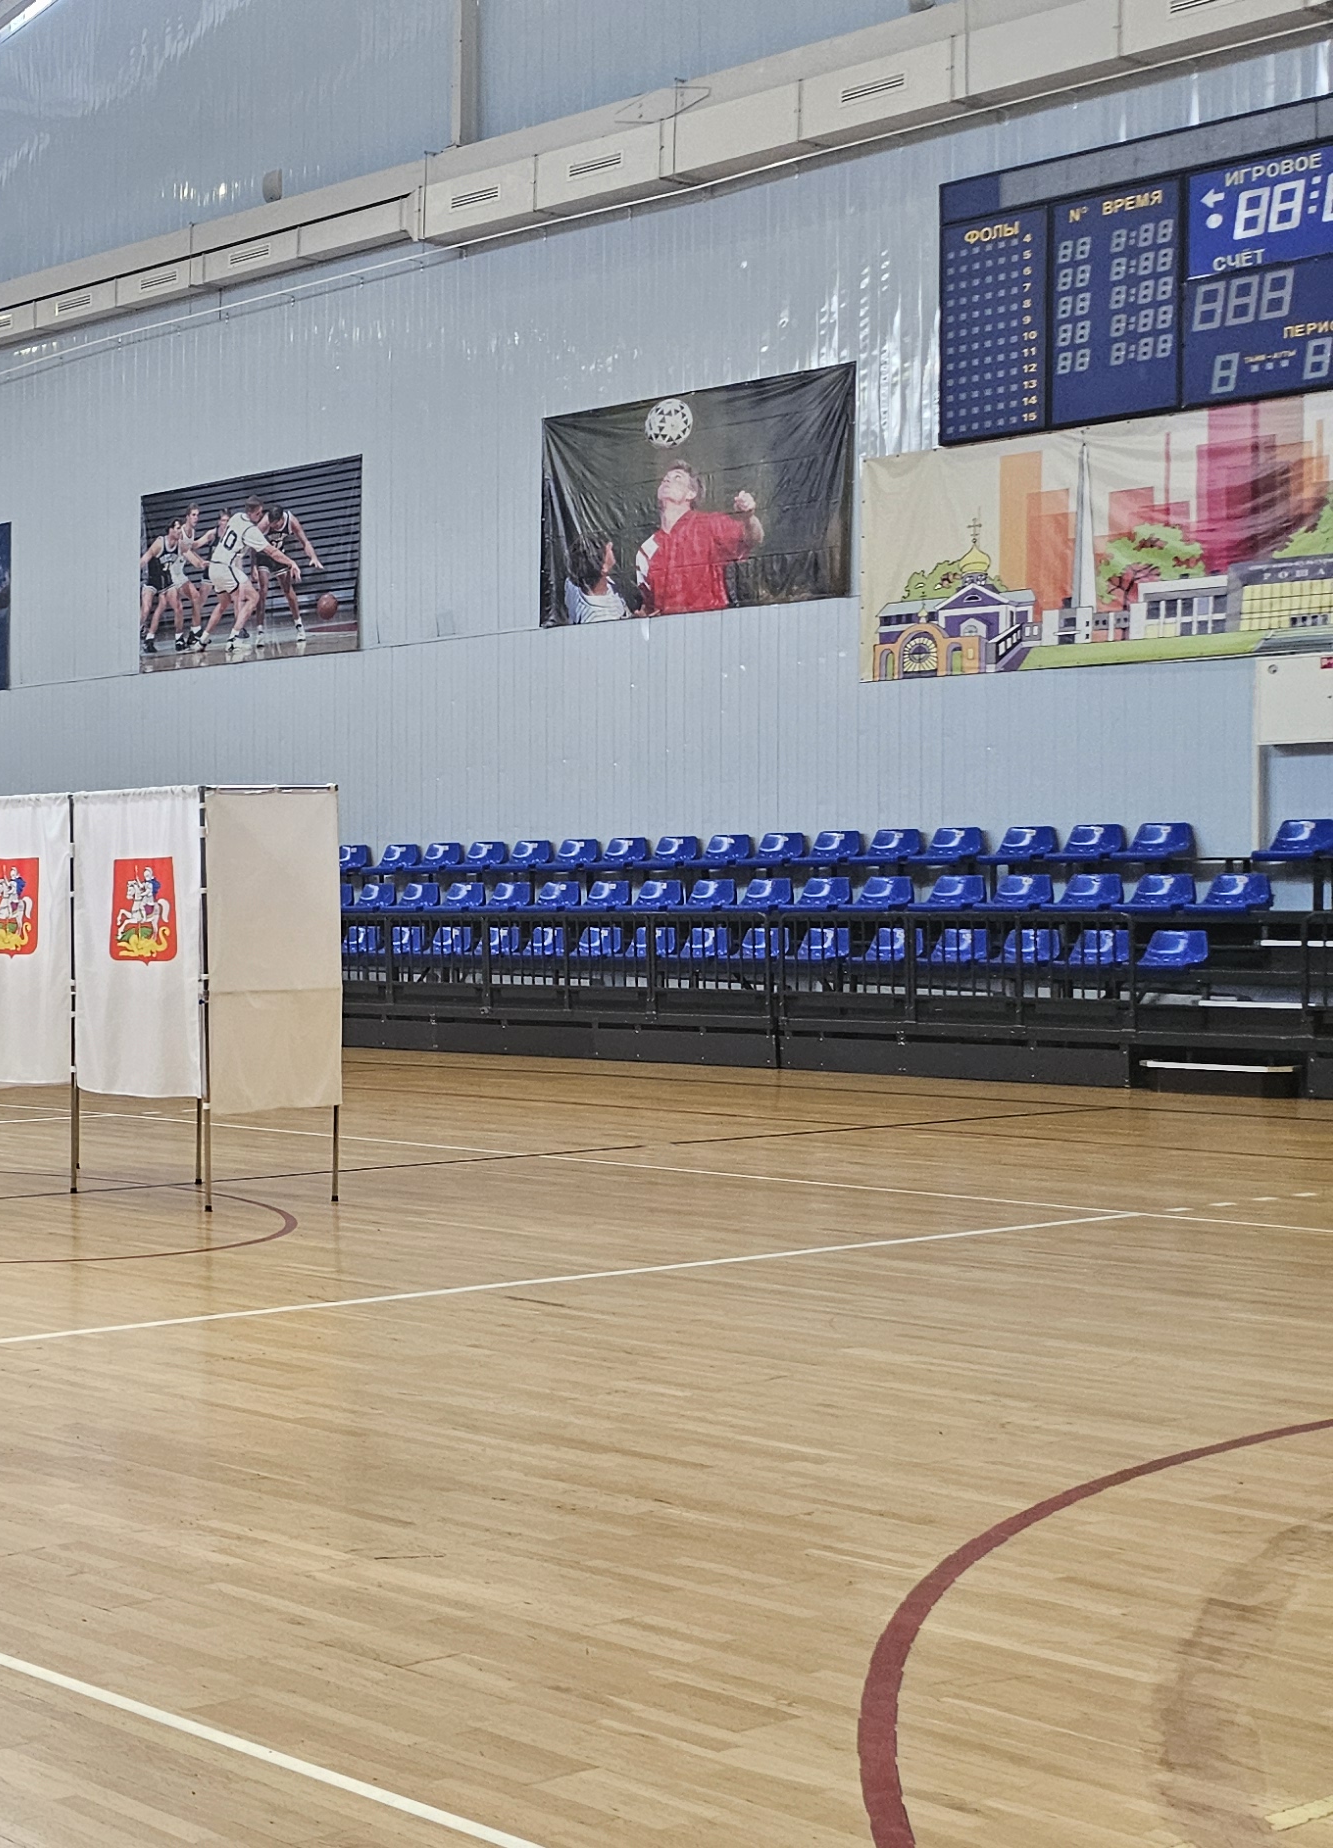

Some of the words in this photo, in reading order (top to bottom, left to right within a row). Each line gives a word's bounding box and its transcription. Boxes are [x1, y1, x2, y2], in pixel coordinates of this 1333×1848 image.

[1225, 152, 1322, 187] ИГРОВОЕ
[1102, 189, 1164, 215] ВРЕМЯ
[964, 220, 1020, 244] ФОЛЫ
[1022, 233, 1032, 243] 4
[1022, 249, 1032, 260] 5
[1212, 247, 1267, 271] СЧЁТ
[1022, 266, 1032, 276] 6
[1022, 282, 1031, 293] 7
[1022, 298, 1032, 308] 8
[1022, 315, 1032, 325] 9
[1283, 320, 1333, 339] ПЕРИ
[1022, 330, 1037, 341] 10
[1022, 346, 1037, 357] 11
[1022, 363, 1037, 373] 12
[1022, 379, 1037, 390] 13
[1022, 395, 1037, 406] 14
[1022, 411, 1037, 422] 15
